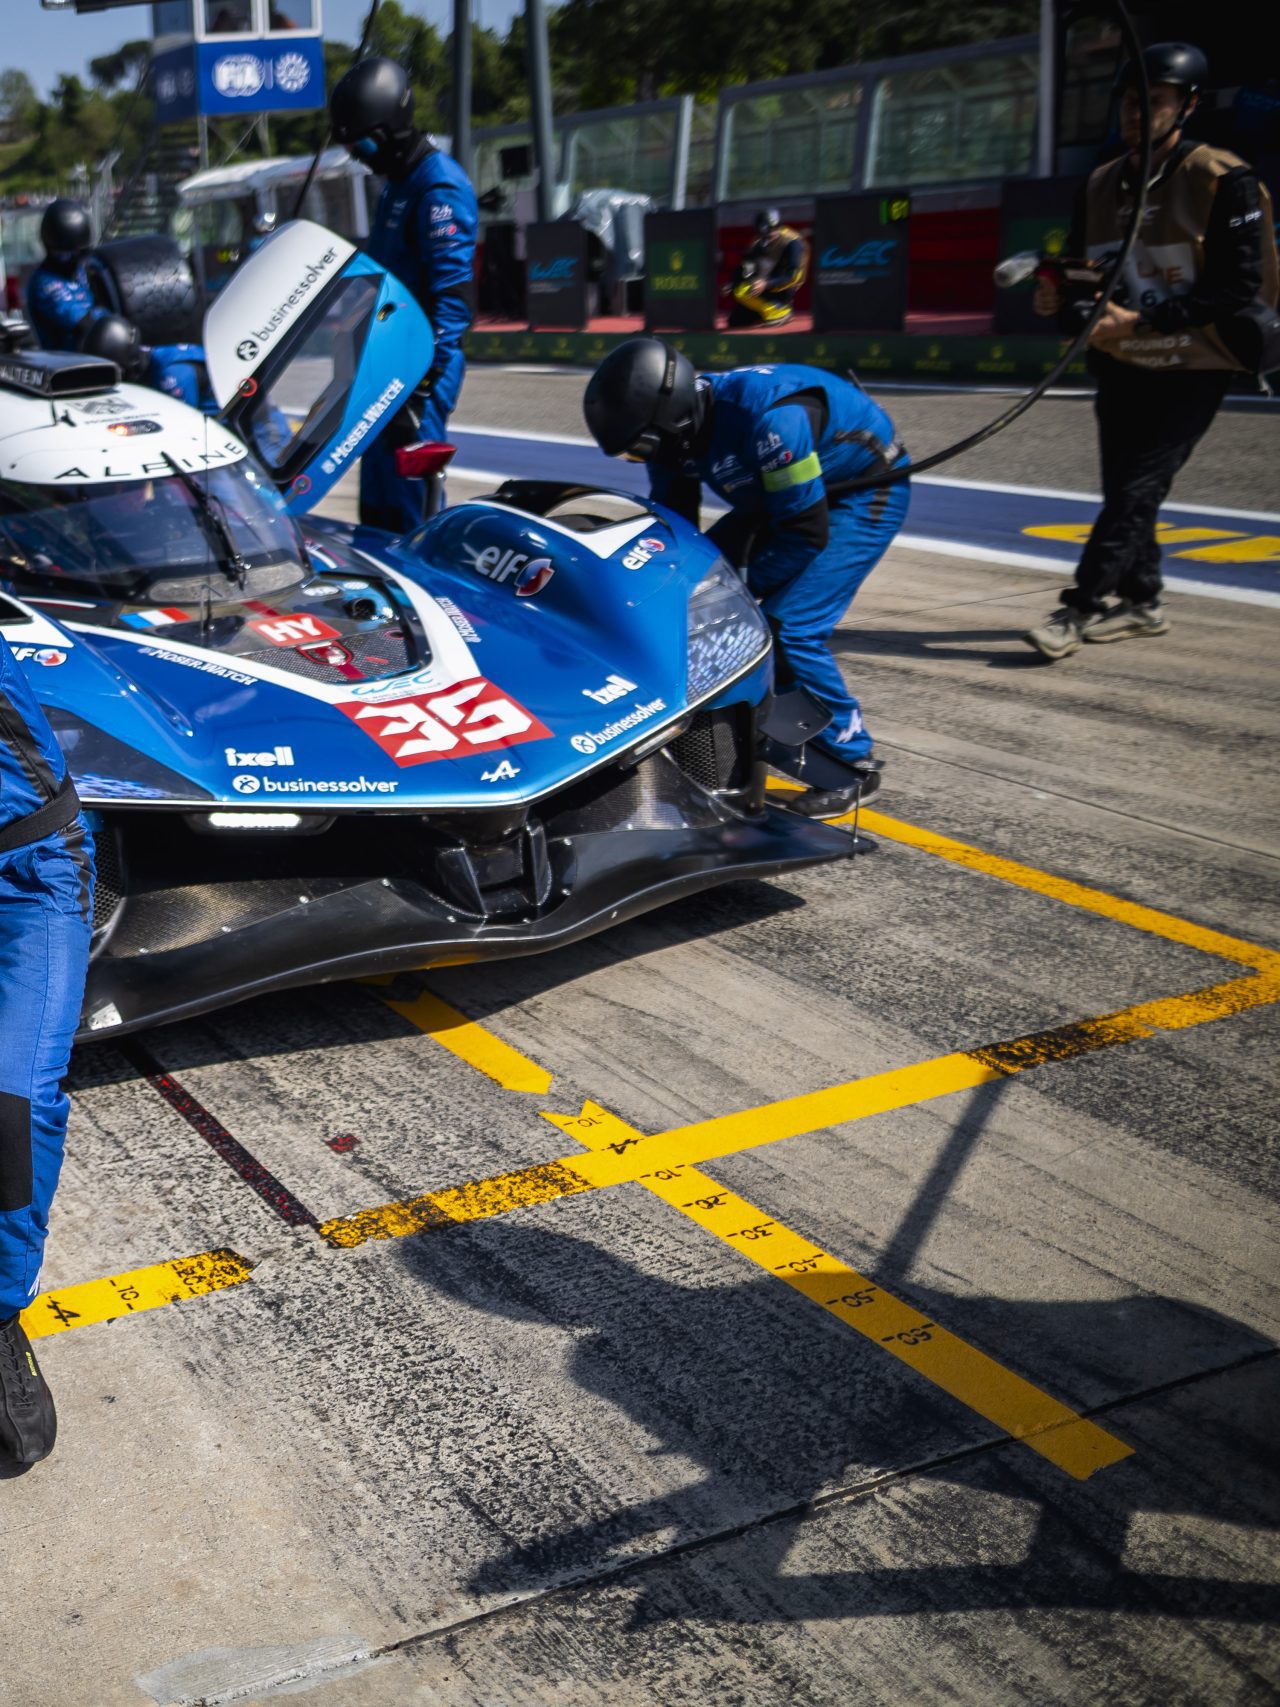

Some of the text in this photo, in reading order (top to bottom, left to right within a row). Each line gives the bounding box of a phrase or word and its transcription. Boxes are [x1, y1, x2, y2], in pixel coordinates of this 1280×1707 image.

[252, 246, 338, 342] businessolver
[1179, 334, 1192, 347] 2
[54, 442, 244, 480] ALPINE
[475, 546, 528, 583] elf
[622, 543, 653, 570] elf
[258, 617, 322, 642] HY
[581, 674, 639, 705] ixell
[354, 682, 533, 759] 36
[585, 698, 668, 746] businessolver
[224, 746, 295, 767] ixell
[263, 776, 399, 793] businessolver
